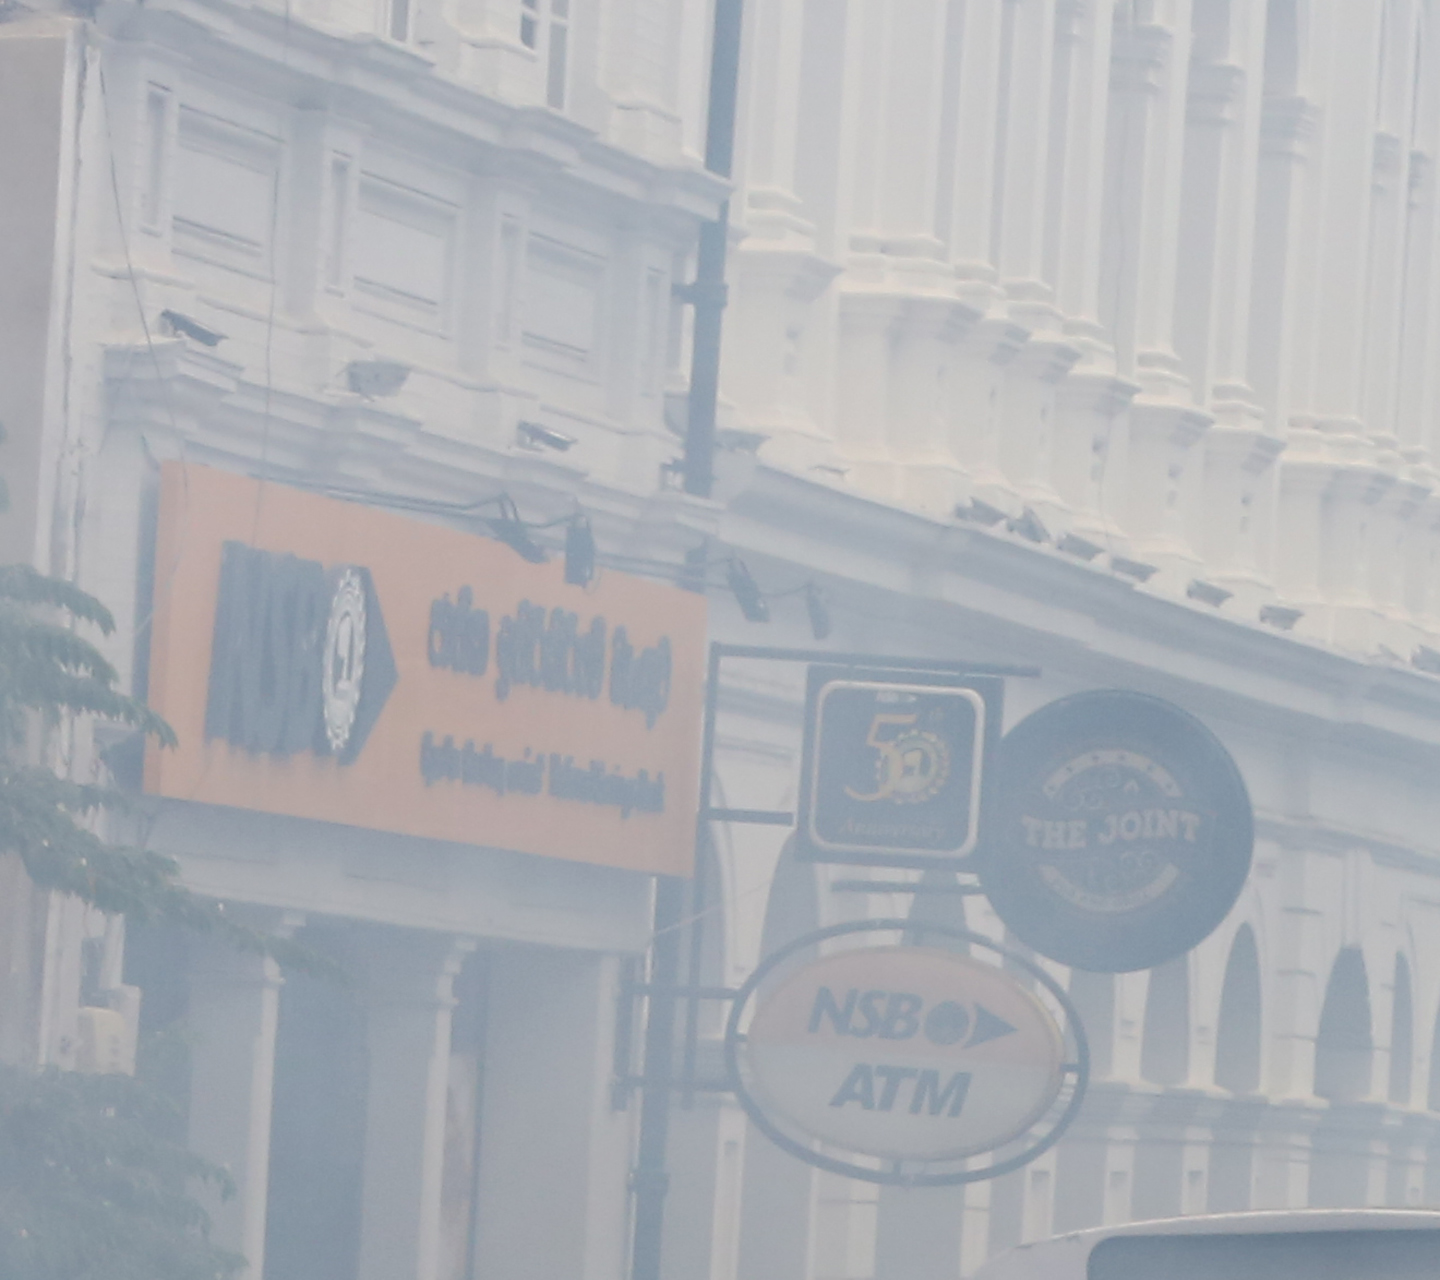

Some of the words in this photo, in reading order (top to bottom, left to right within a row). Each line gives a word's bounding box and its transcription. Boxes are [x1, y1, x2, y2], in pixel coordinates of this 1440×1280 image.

[1020, 813, 1087, 849] THE
[1097, 809, 1201, 845] JOINT
[807, 985, 922, 1039] NSB
[829, 1063, 972, 1117] ATM
